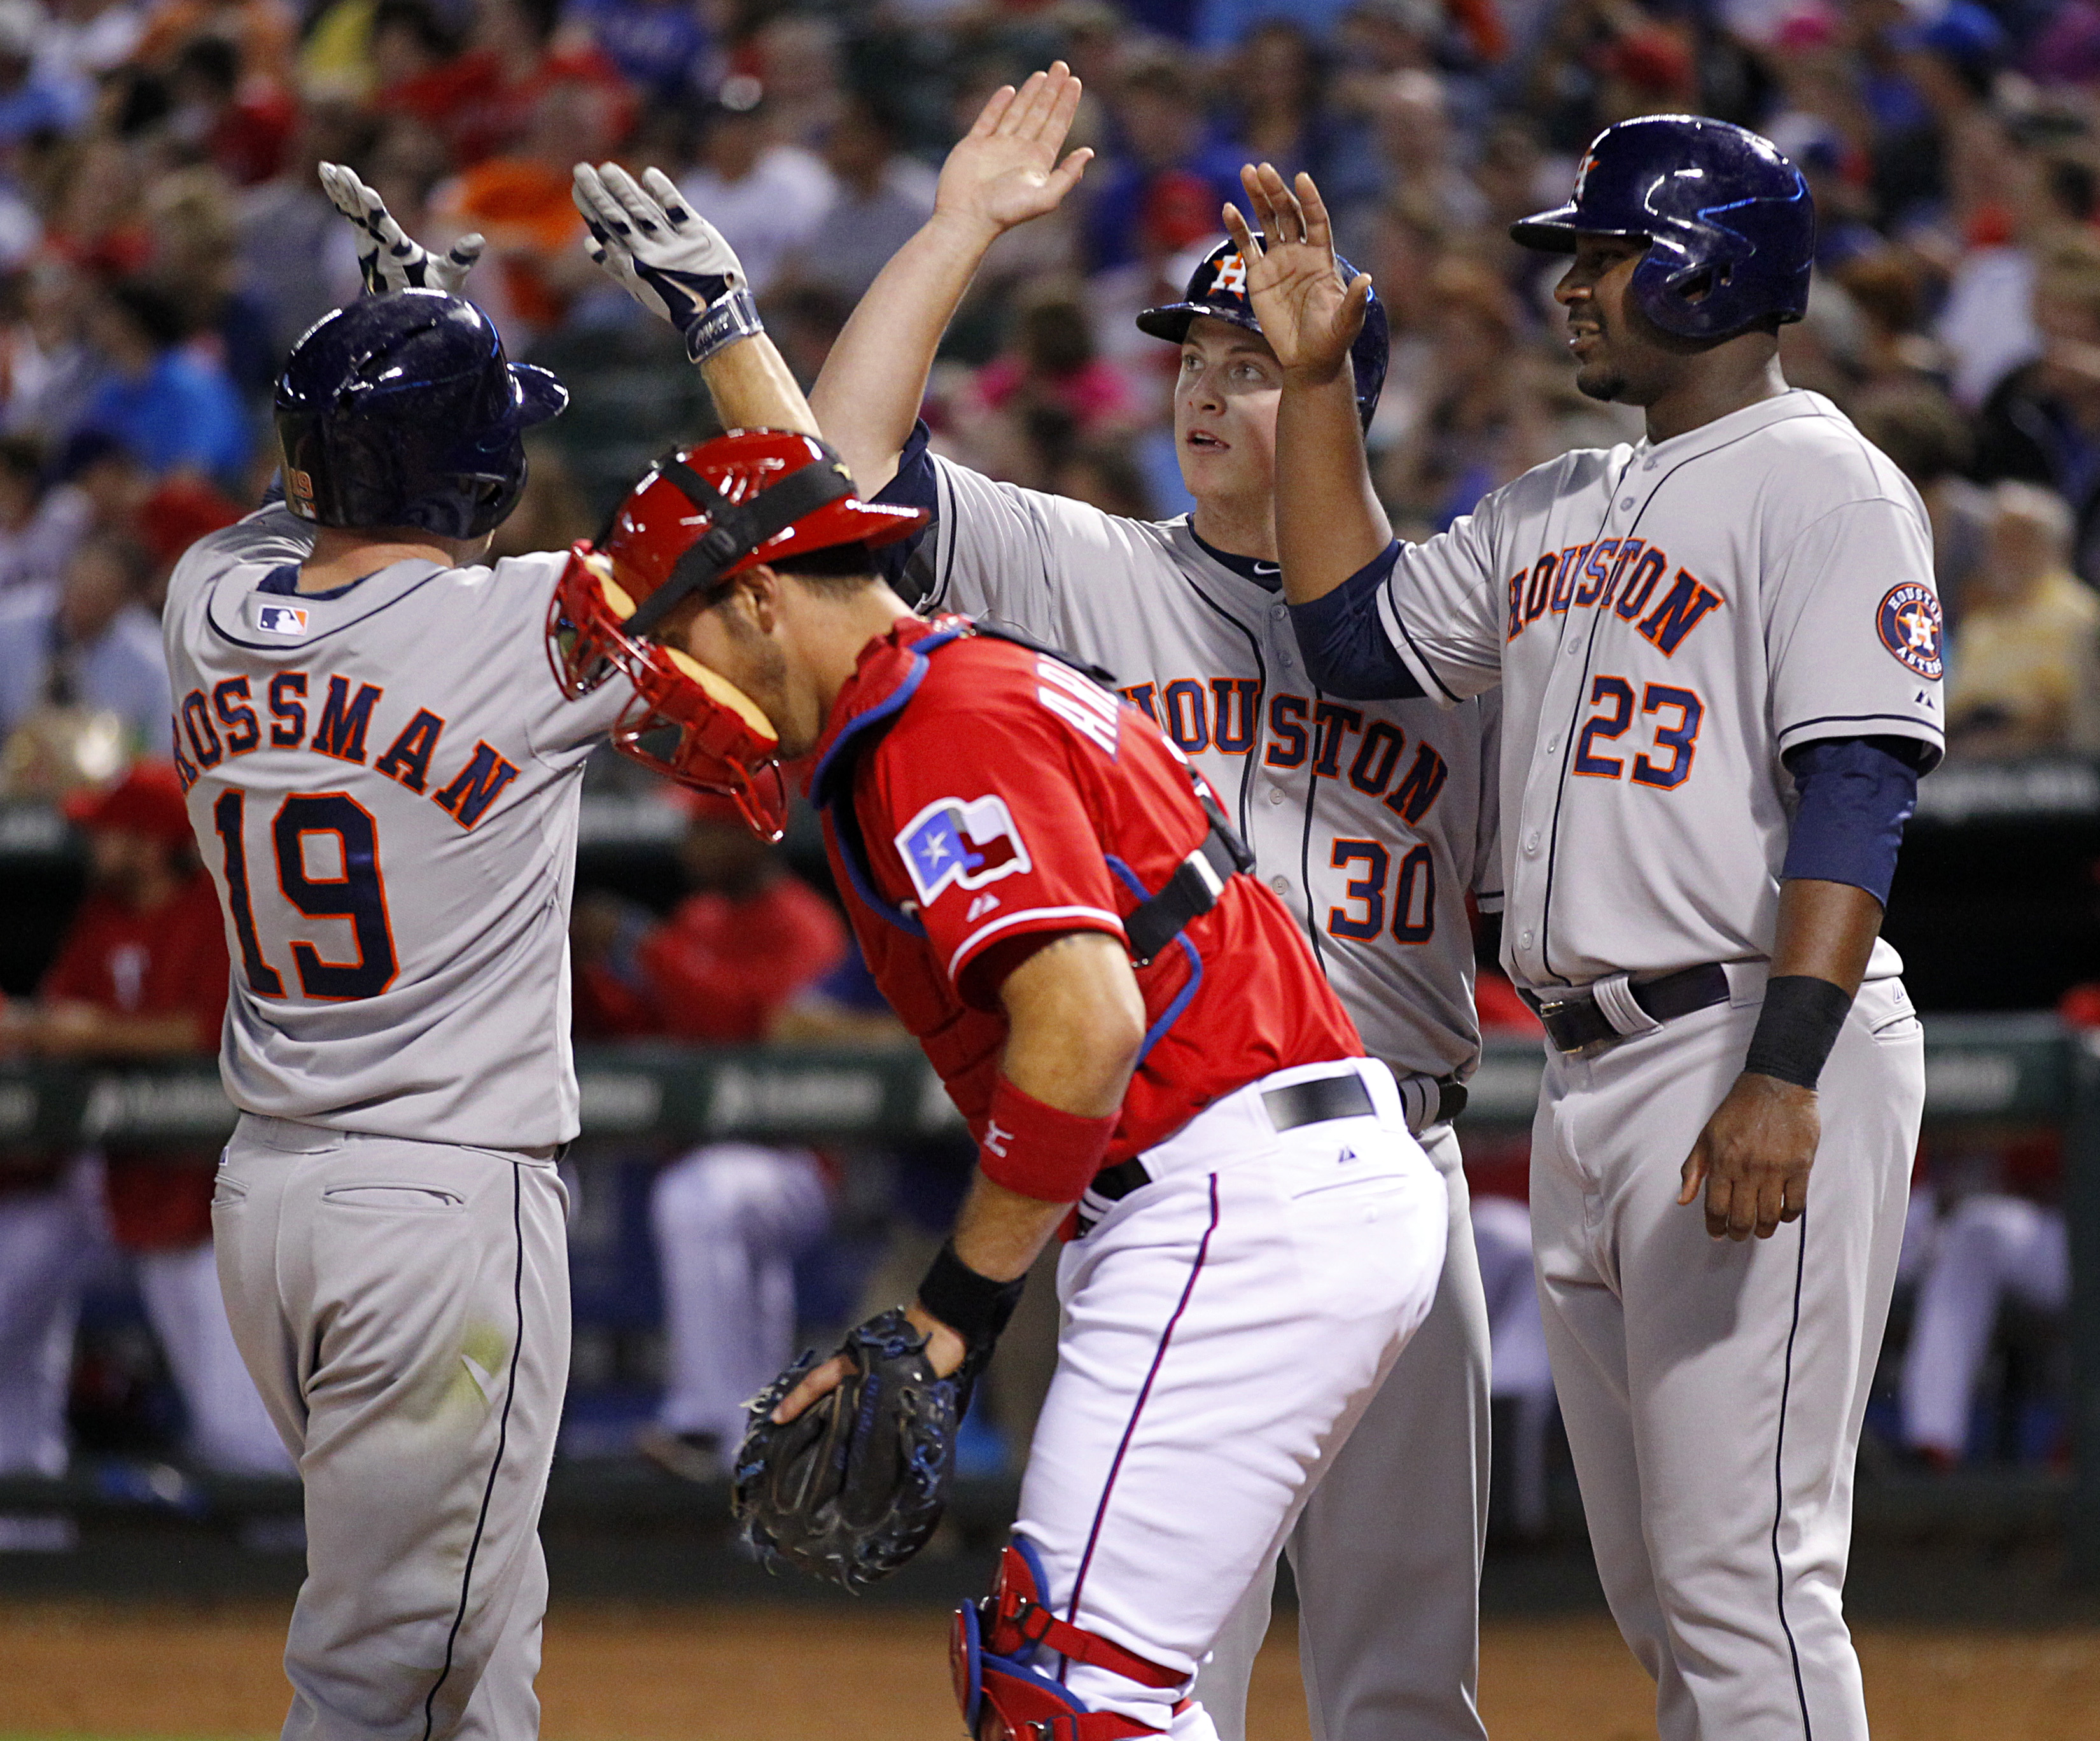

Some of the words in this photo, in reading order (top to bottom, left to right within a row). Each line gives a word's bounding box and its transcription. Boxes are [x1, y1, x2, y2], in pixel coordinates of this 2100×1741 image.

[1211, 255, 1247, 293] H
[1506, 538, 1724, 659] HOUSTON
[1887, 587, 1942, 623] HOUSTON
[1905, 612, 1935, 650] H
[1572, 675, 1705, 791] 23
[214, 789, 400, 1001] 19
[1327, 837, 1436, 945] 30
